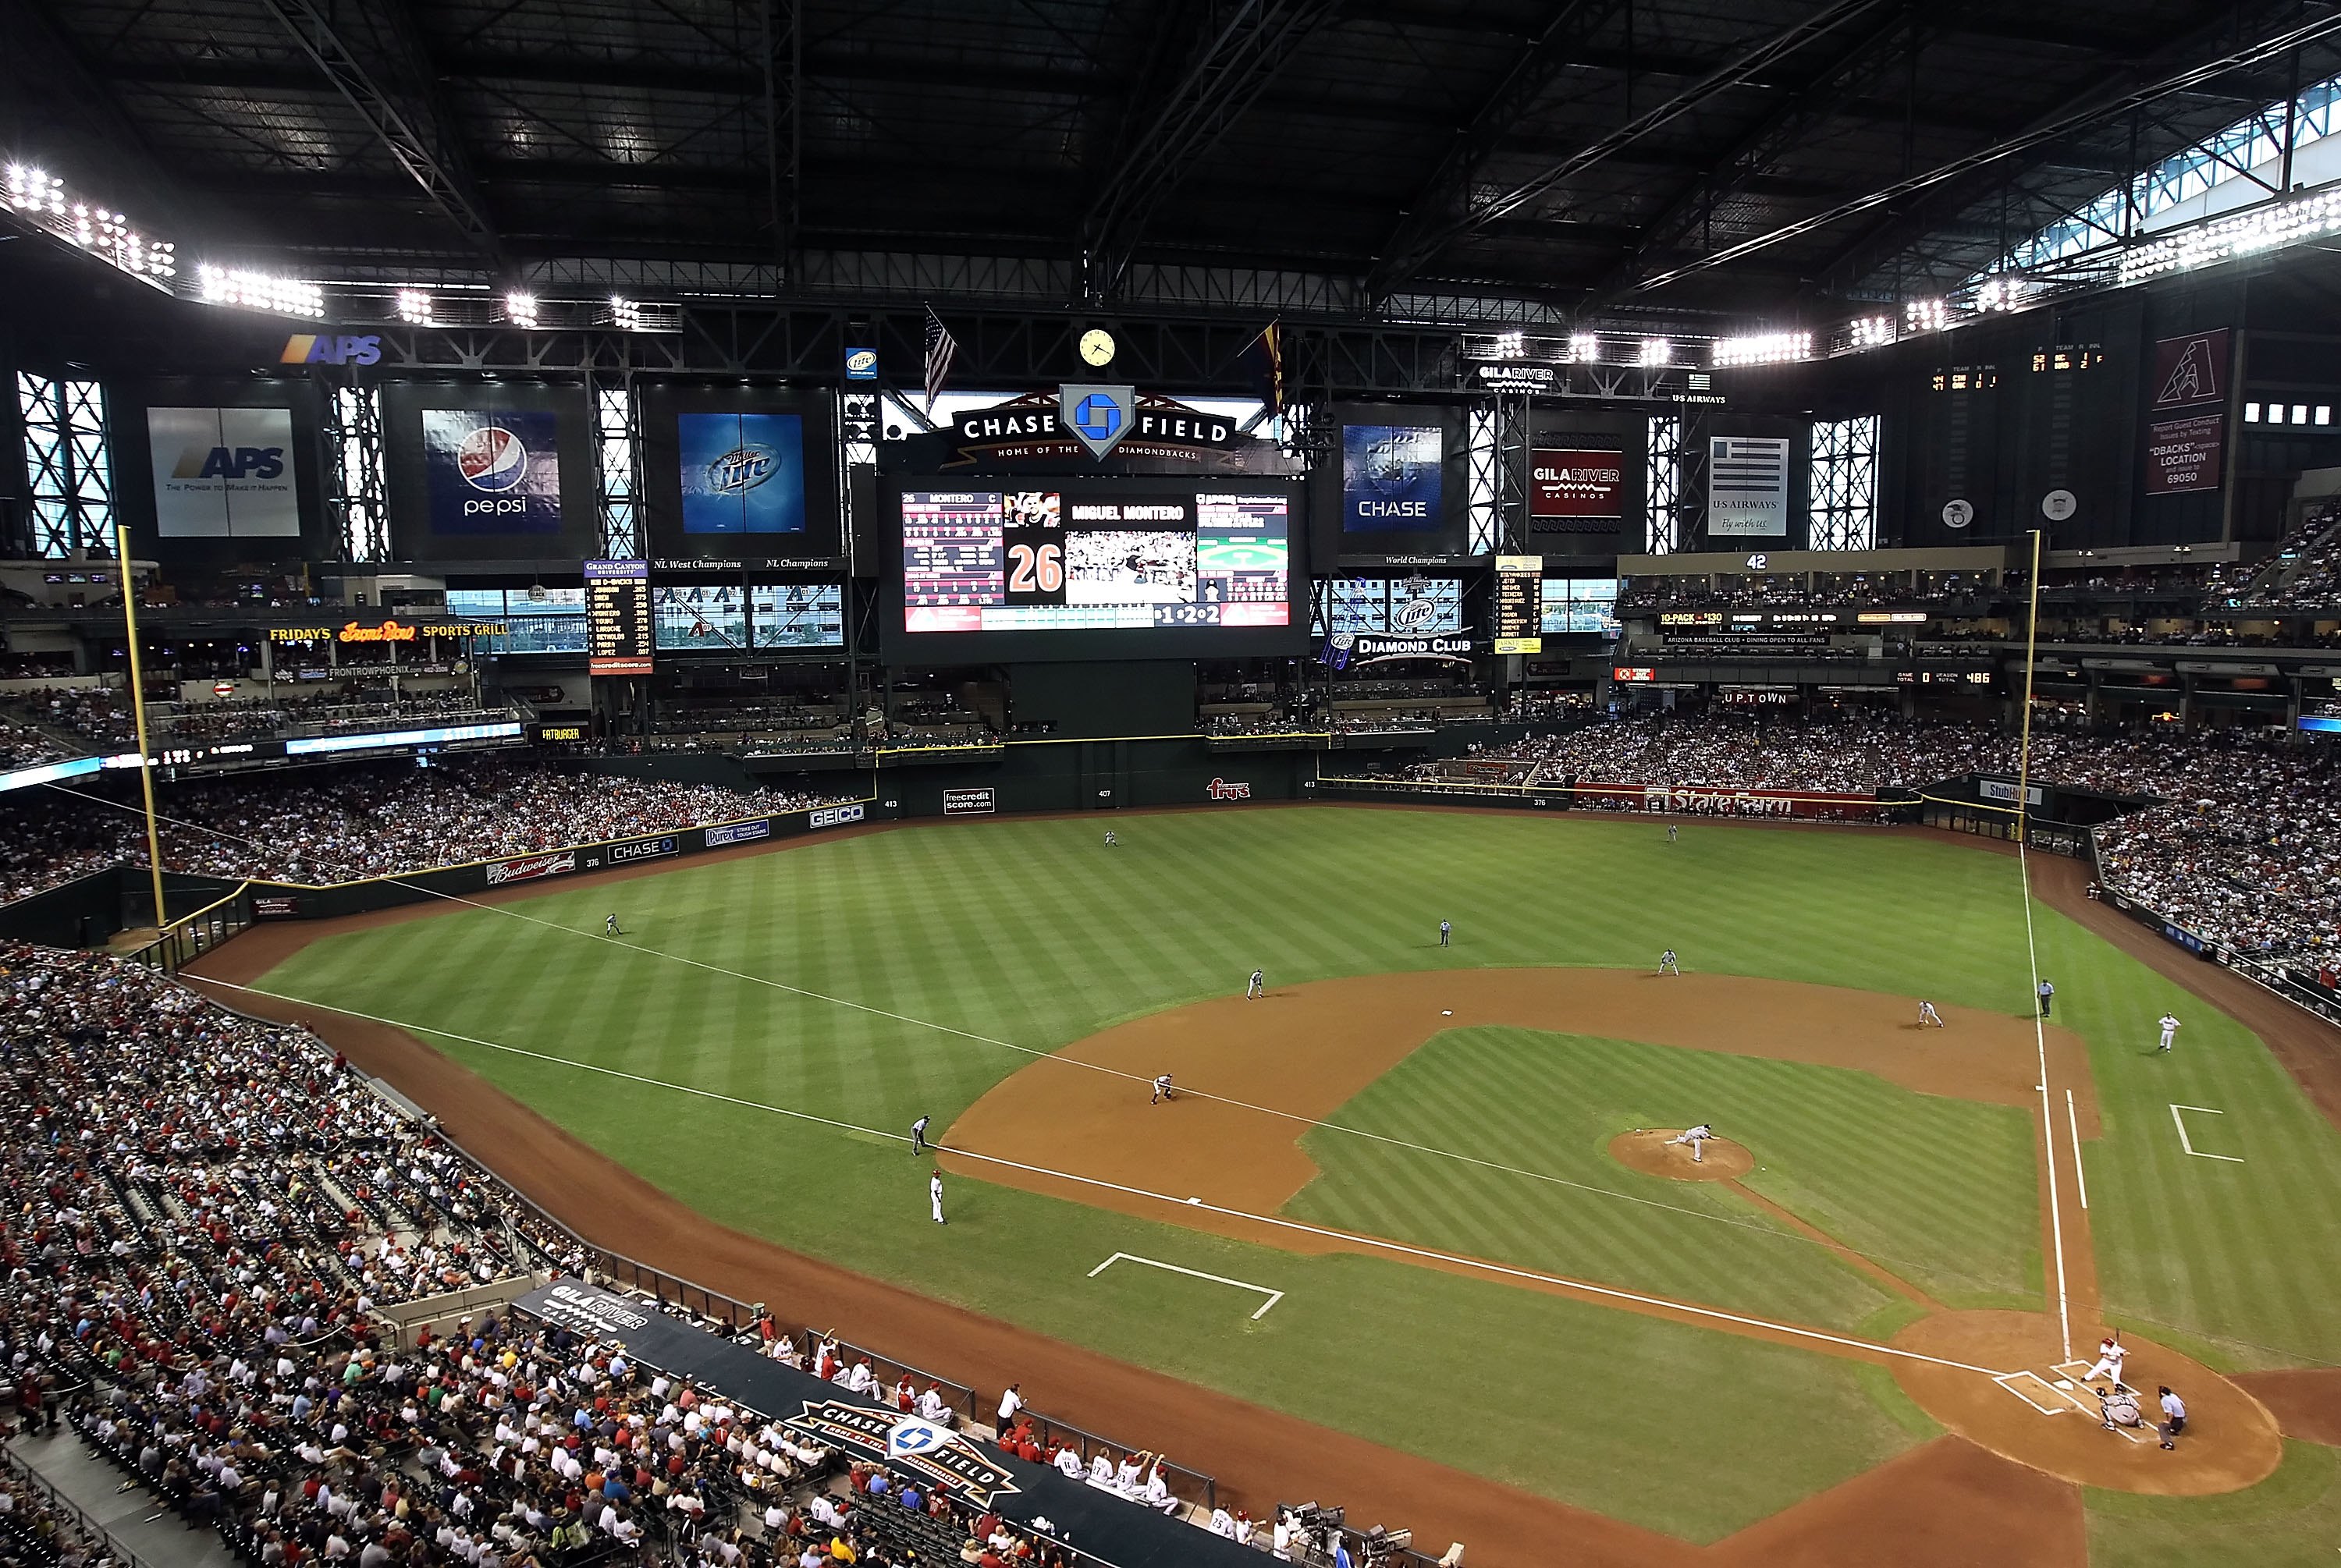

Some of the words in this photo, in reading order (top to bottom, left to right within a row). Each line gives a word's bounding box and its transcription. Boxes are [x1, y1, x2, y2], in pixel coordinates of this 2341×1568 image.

[305, 335, 381, 365] APS
[1480, 367, 1512, 379] GILA
[1512, 367, 1554, 381] RIVER
[1687, 395, 1726, 403] AIRWAYS
[963, 415, 1054, 438] CHASE
[1142, 417, 1227, 442] FIELD
[998, 447, 1028, 457] HOME
[1058, 445, 1078, 454] THE
[1119, 446, 1197, 459] DIAMONDBACKS
[2161, 452, 2207, 466] LOCATION
[199, 447, 284, 479] APS
[719, 457, 770, 491] Lite
[1534, 468, 1572, 481] GILA
[1572, 469, 1620, 482] RIVER
[2167, 473, 2197, 484] 69050
[464, 496, 526, 516] pepsi
[929, 494, 974, 504] MONTERO
[988, 494, 996, 503] C
[1071, 506, 1121, 520] MIGUEL
[1124, 506, 1185, 520] MONTERO
[1359, 501, 1426, 518] CHASE
[1722, 518, 1733, 531] Fly
[1735, 519, 1754, 527] with
[654, 560, 667, 569] NL
[693, 560, 741, 569] Champions
[780, 559, 829, 569] Champions
[1385, 556, 1407, 565] World
[1408, 555, 1447, 566] Champions
[1746, 555, 1767, 569] 42
[1008, 543, 1063, 593] 26
[1162, 605, 1174, 624] 1
[1184, 605, 1197, 623] 2
[1206, 605, 1220, 623] 2
[1406, 607, 1430, 623] Lite
[1661, 613, 1695, 622] 10-PACK
[1704, 612, 1723, 621] $130
[270, 627, 331, 641] FRIDAY'S
[339, 623, 382, 642] Front
[382, 621, 415, 641] Row
[423, 626, 471, 637] SPORTS
[474, 624, 507, 636] GRILL
[1359, 640, 1428, 654] DIAMOND
[1432, 638, 1471, 652] CLUB
[329, 666, 421, 677] FRONTROWPHOENIX.com
[1966, 672, 1990, 683] 486
[543, 729, 579, 740] FATBURGER
[946, 792, 989, 801] freecredit
[1675, 789, 1731, 811] State
[1990, 784, 2031, 802] StubHu!
[811, 805, 864, 827] GEICO
[709, 828, 734, 844] Purex
[615, 841, 660, 859] CHASE
[494, 853, 560, 882] Budweiser
[587, 858, 599, 867] 376
[551, 1286, 595, 1308] GILA
[586, 1300, 648, 1331] RIVER
[542, 1307, 601, 1335] CASINOS
[822, 1408, 887, 1434] CHASE
[934, 1449, 995, 1484] FIELD
[829, 1426, 851, 1437] HOME
[869, 1440, 883, 1449] THE
[907, 1456, 959, 1485] DIAMONDBACKS
[1092, 1467, 1100, 1476] 27
[1118, 1473, 1125, 1483] 23
[1213, 1518, 1224, 1529] 25
